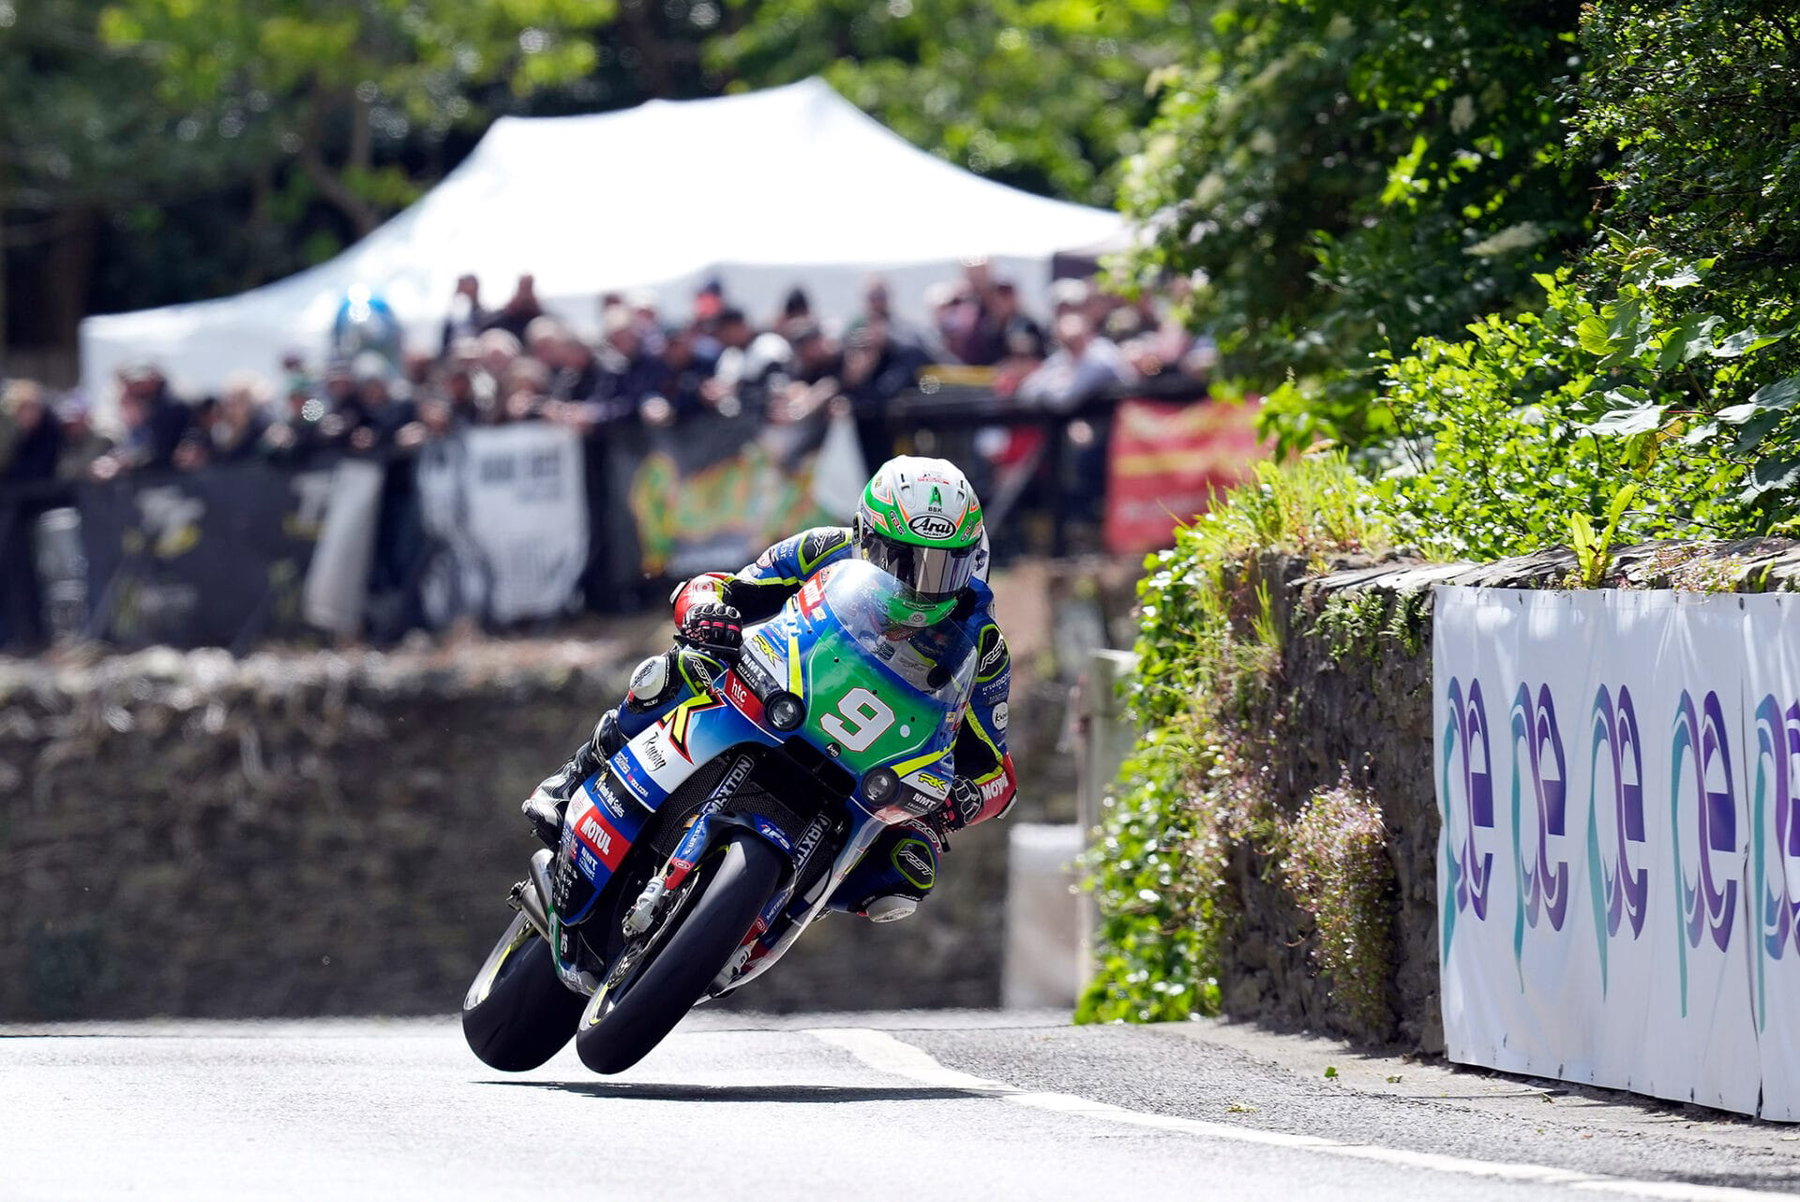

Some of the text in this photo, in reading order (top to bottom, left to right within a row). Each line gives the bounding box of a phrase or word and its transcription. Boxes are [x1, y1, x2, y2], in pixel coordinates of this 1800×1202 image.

[911, 517, 951, 534] Arai
[741, 653, 767, 681] NMT
[731, 677, 747, 703] htc
[819, 687, 896, 752] 9
[707, 758, 752, 815] MAXTON
[912, 792, 937, 808] NMT
[580, 816, 612, 856] MOTUL
